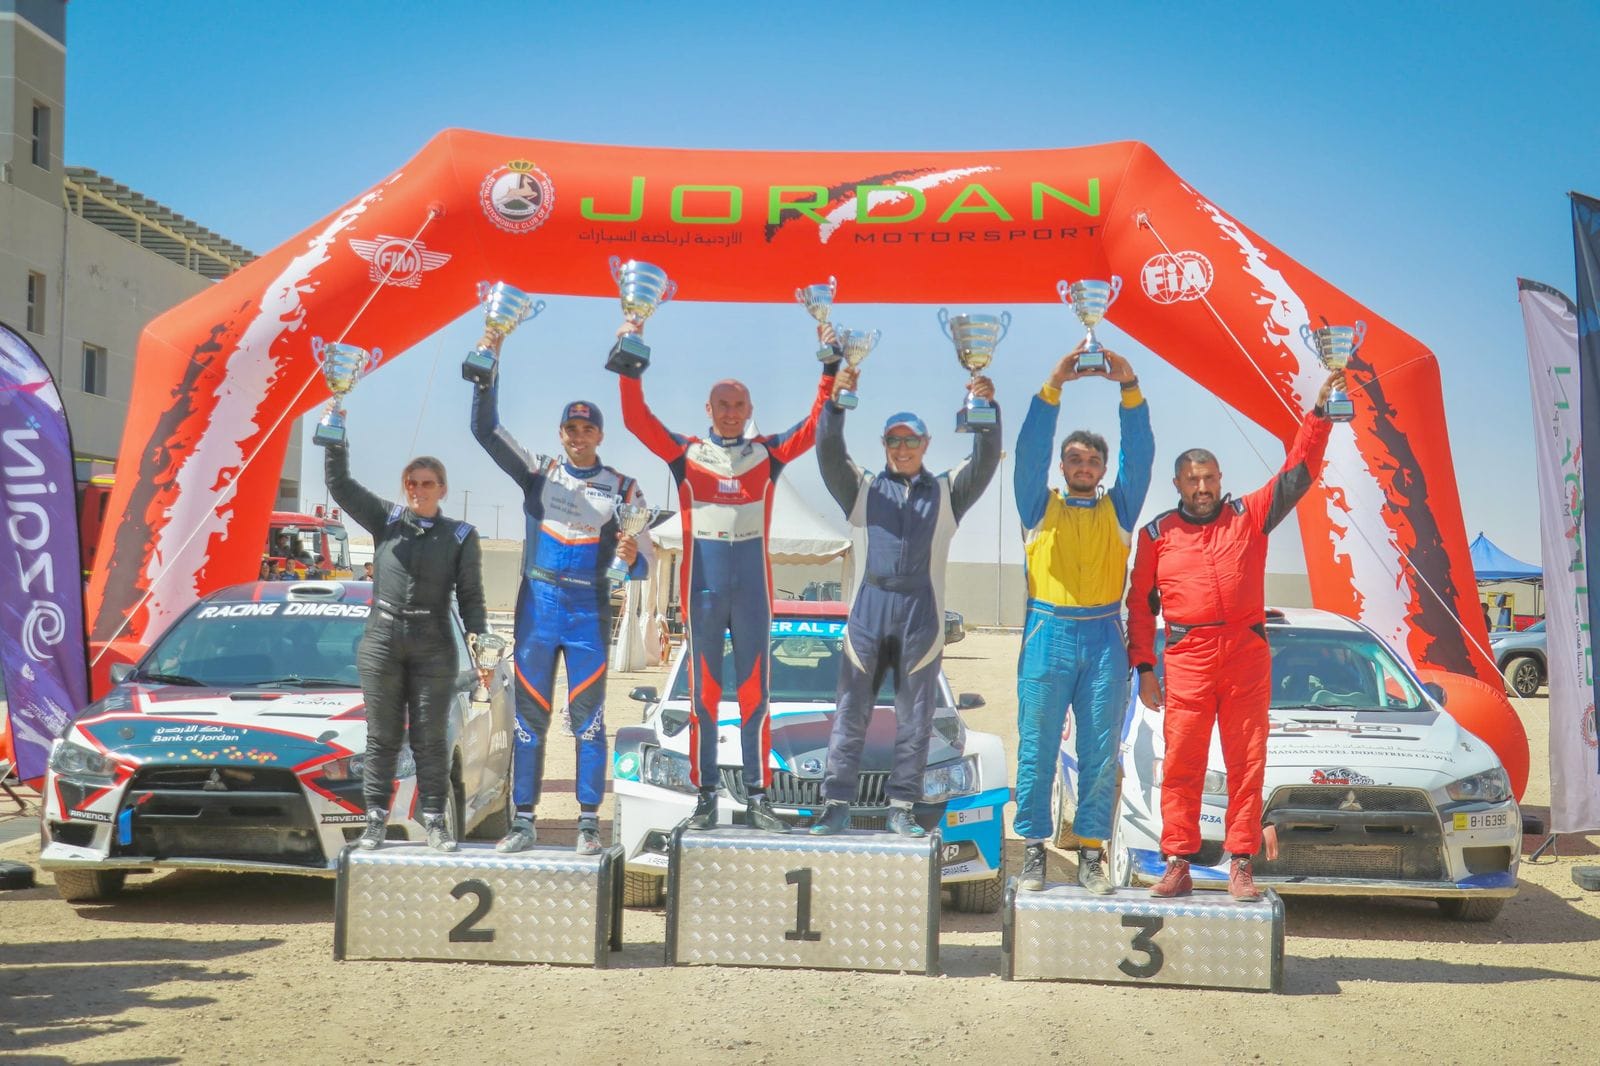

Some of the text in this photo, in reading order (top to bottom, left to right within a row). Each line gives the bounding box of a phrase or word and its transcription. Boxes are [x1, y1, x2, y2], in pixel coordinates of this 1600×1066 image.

[483, 177, 496, 199] ROYAL
[580, 176, 1100, 224] JORDAN
[484, 199, 520, 230] AUTOMOBILE
[521, 218, 539, 230] CLUB
[854, 225, 1100, 244] MOTORSPORT
[380, 251, 416, 273] FIM
[197, 602, 281, 619] RACING
[797, 622, 824, 633] AL
[152, 733, 240, 743] Bank of Jordan
[1350, 750, 1413, 758] INDUSTRIES
[1200, 813, 1222, 824] R3A
[449, 879, 496, 943] 2
[784, 867, 822, 942] 1
[1117, 914, 1165, 979] 3
